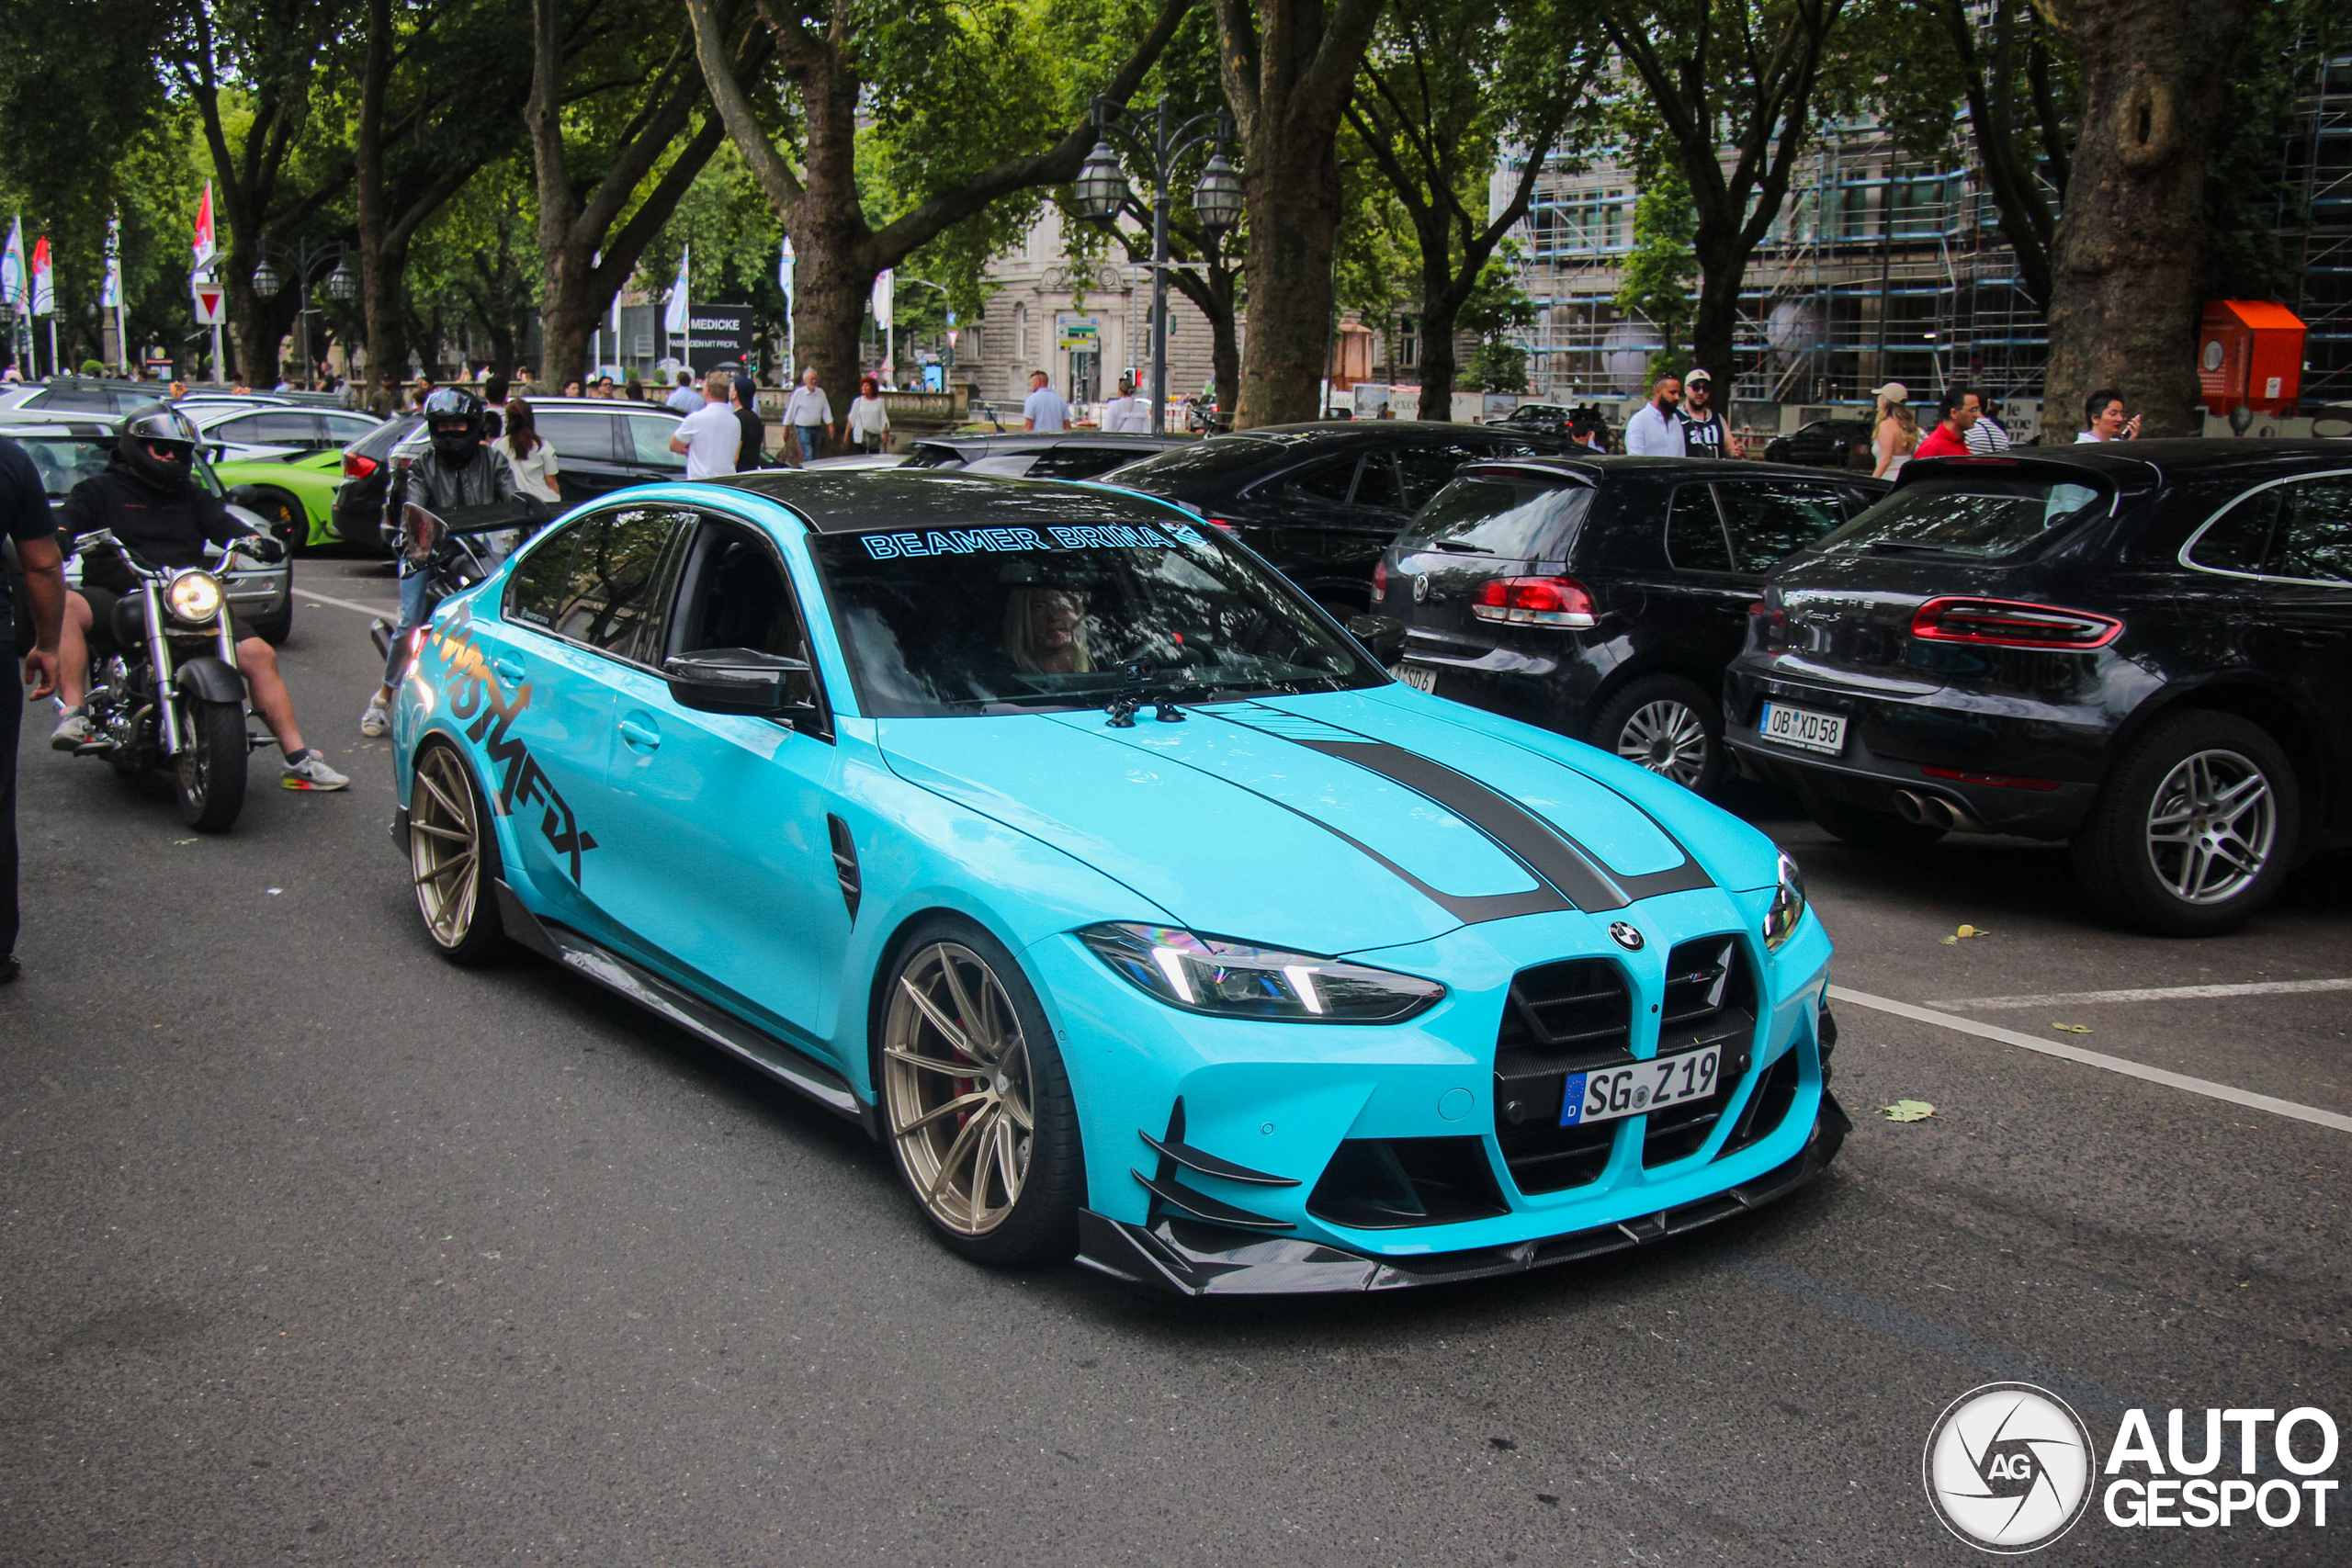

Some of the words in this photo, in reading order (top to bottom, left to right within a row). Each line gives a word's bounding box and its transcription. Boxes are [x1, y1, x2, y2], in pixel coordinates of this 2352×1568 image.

[691, 318, 740, 331] MEDICKE
[2007, 403, 2020, 416] le
[1690, 424, 1719, 445] atl
[860, 527, 1051, 560] BEAMER
[1046, 525, 1177, 548] BRINA
[1783, 591, 1876, 609] PORSCHE
[1772, 710, 1791, 734] OB
[1585, 1070, 1633, 1116] SG
[1566, 1105, 1577, 1117] D
